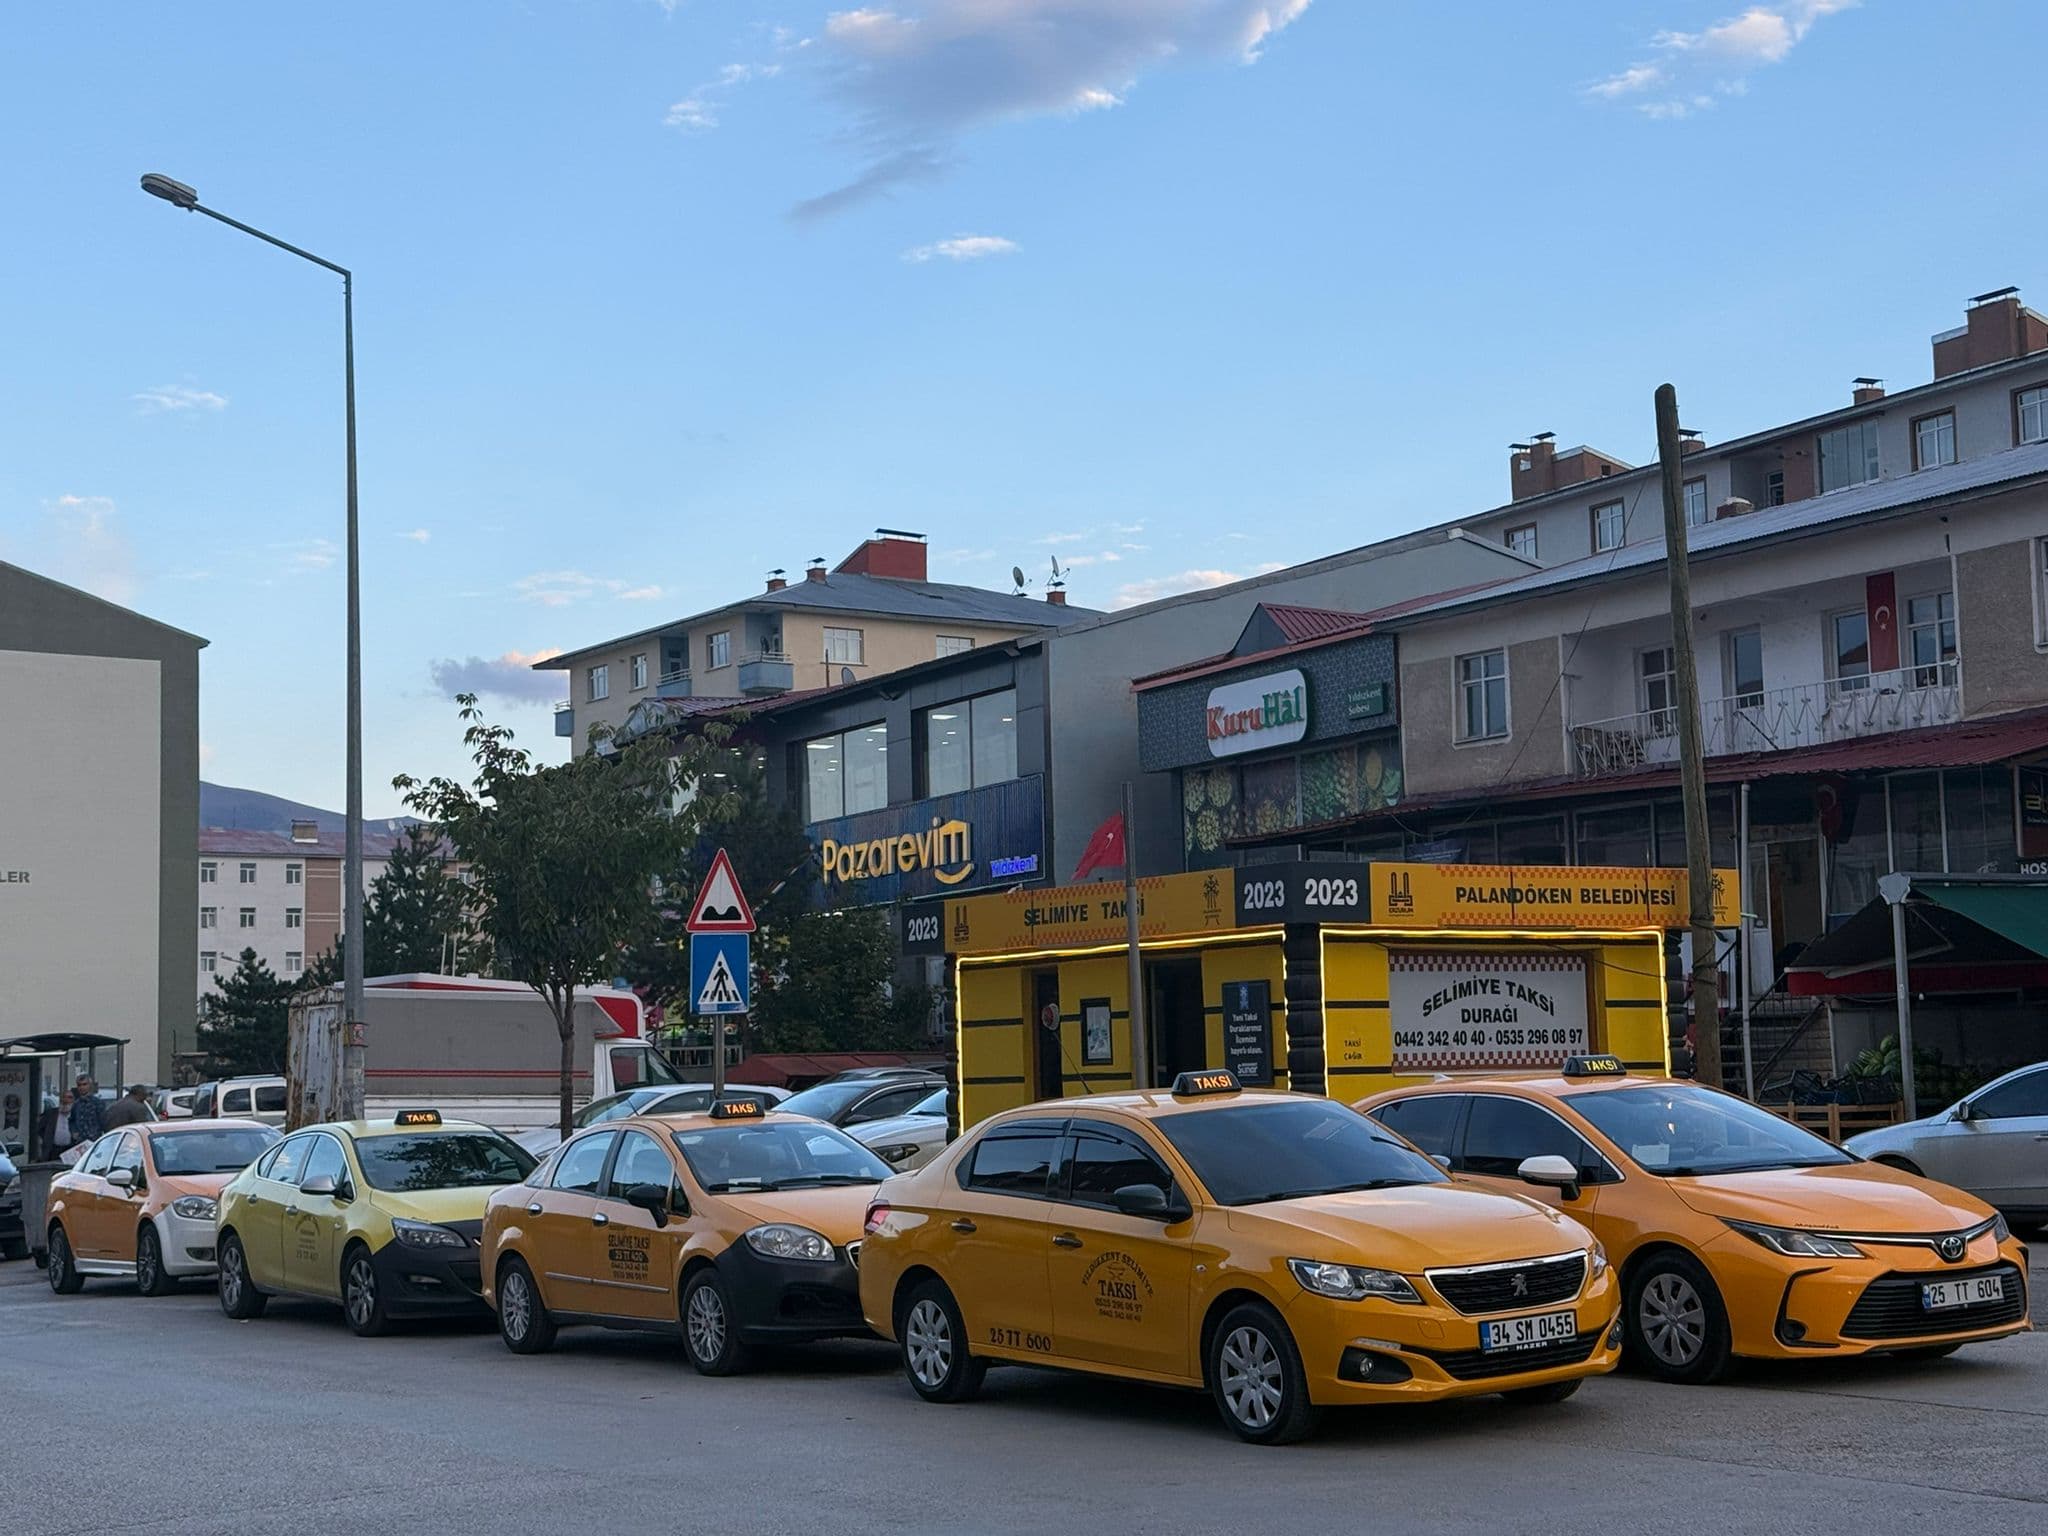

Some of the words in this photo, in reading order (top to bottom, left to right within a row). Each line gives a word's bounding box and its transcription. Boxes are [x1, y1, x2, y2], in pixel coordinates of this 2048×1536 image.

[823, 816, 973, 884] Pazarevim
[1243, 879, 1286, 910] 2023
[1304, 878, 1359, 907] 2023
[1455, 883, 1572, 905] PALANDÖKEN
[1580, 883, 1676, 906] BELEDİYESİ
[1024, 900, 1089, 928] SELİMİYE
[907, 916, 939, 942] 2023
[1422, 974, 1501, 1017] SELİMİYE
[1505, 980, 1555, 1017] TAKSİ
[1461, 1003, 1518, 1024] DURAĞI
[1394, 1030, 1424, 1047] 0442
[1427, 1030, 1450, 1047] 342
[1452, 1029, 1468, 1046] 40
[1470, 1029, 1486, 1046] 40
[1495, 1029, 1525, 1046] 0535
[1527, 1028, 1549, 1045] 296
[1551, 1028, 1566, 1045] 08
[1569, 1028, 1583, 1045] 97
[1097, 1279, 1138, 1301] TAKSİ
[1930, 1285, 1946, 1305] 25
[1954, 1281, 1969, 1301] TT
[1977, 1277, 2001, 1299] 604
[990, 1327, 1005, 1345] 25
[1006, 1328, 1021, 1347] TT
[1026, 1332, 1052, 1351] 600
[1491, 1322, 1511, 1345] 34
[1515, 1319, 1534, 1342] SM
[1539, 1314, 1573, 1339] 0455
